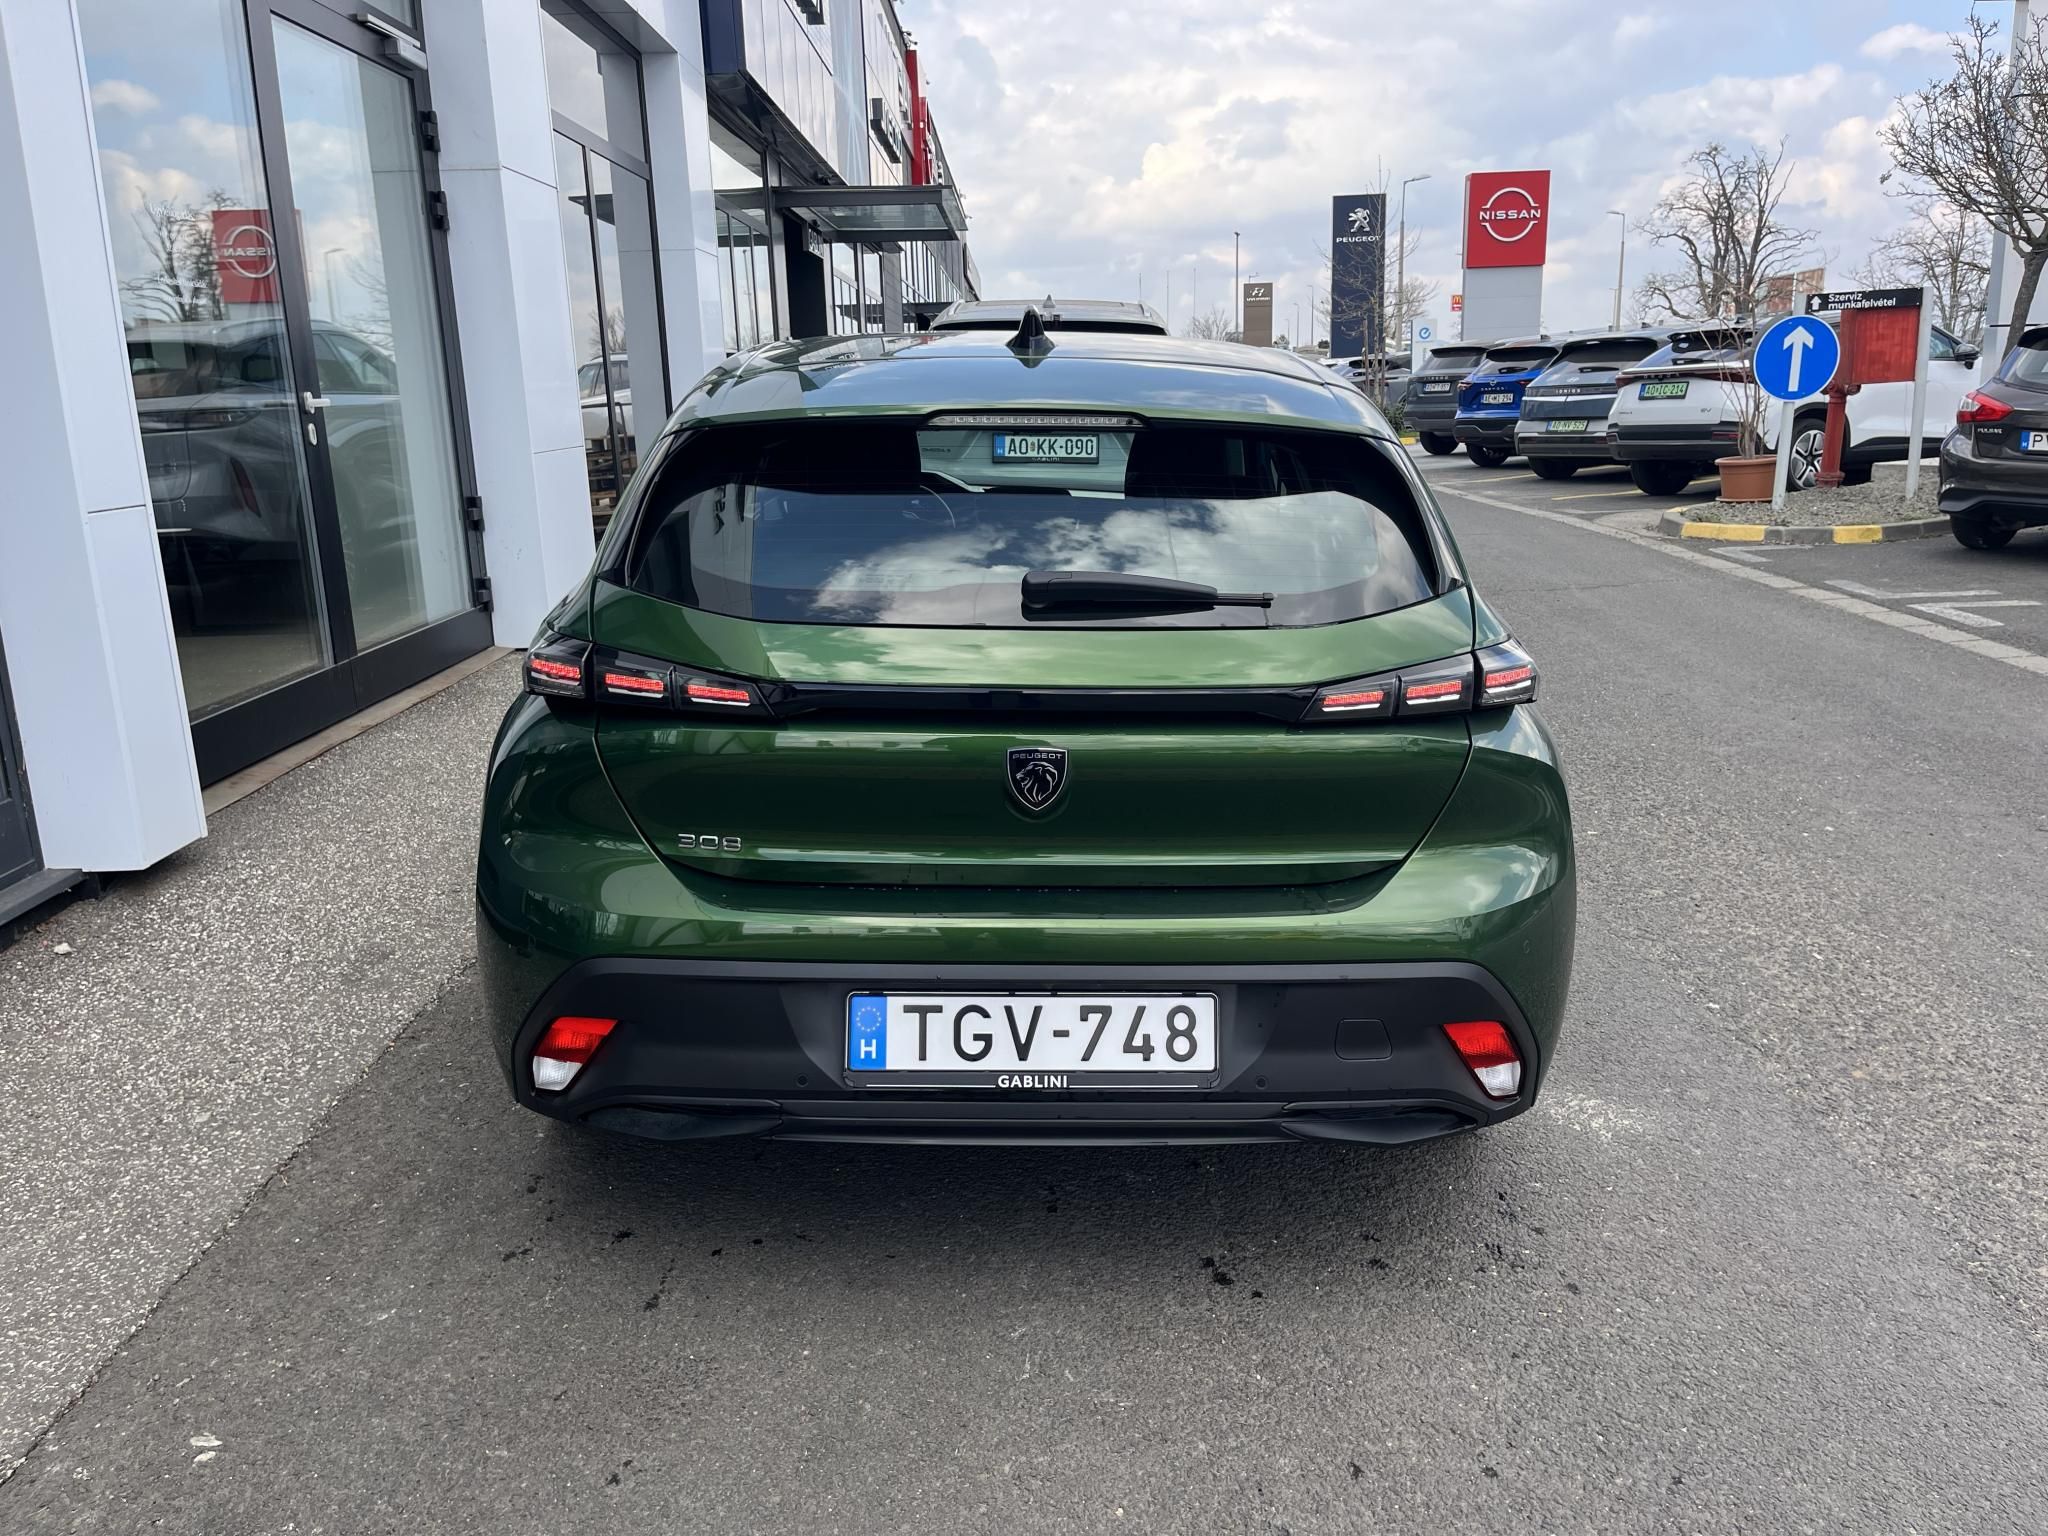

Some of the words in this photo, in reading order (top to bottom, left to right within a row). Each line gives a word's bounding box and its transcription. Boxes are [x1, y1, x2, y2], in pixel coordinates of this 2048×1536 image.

[1480, 208, 1541, 220] NISSAN
[1336, 235, 1380, 243] PEUGEOT
[1828, 292, 1863, 302] Szerviz
[1828, 297, 1897, 310] munkafelvétel
[1012, 752, 1063, 760] PEUGEOT
[677, 833, 742, 852] 308
[903, 1004, 1198, 1063] TGV-748
[997, 1075, 1069, 1088] GABLINI
